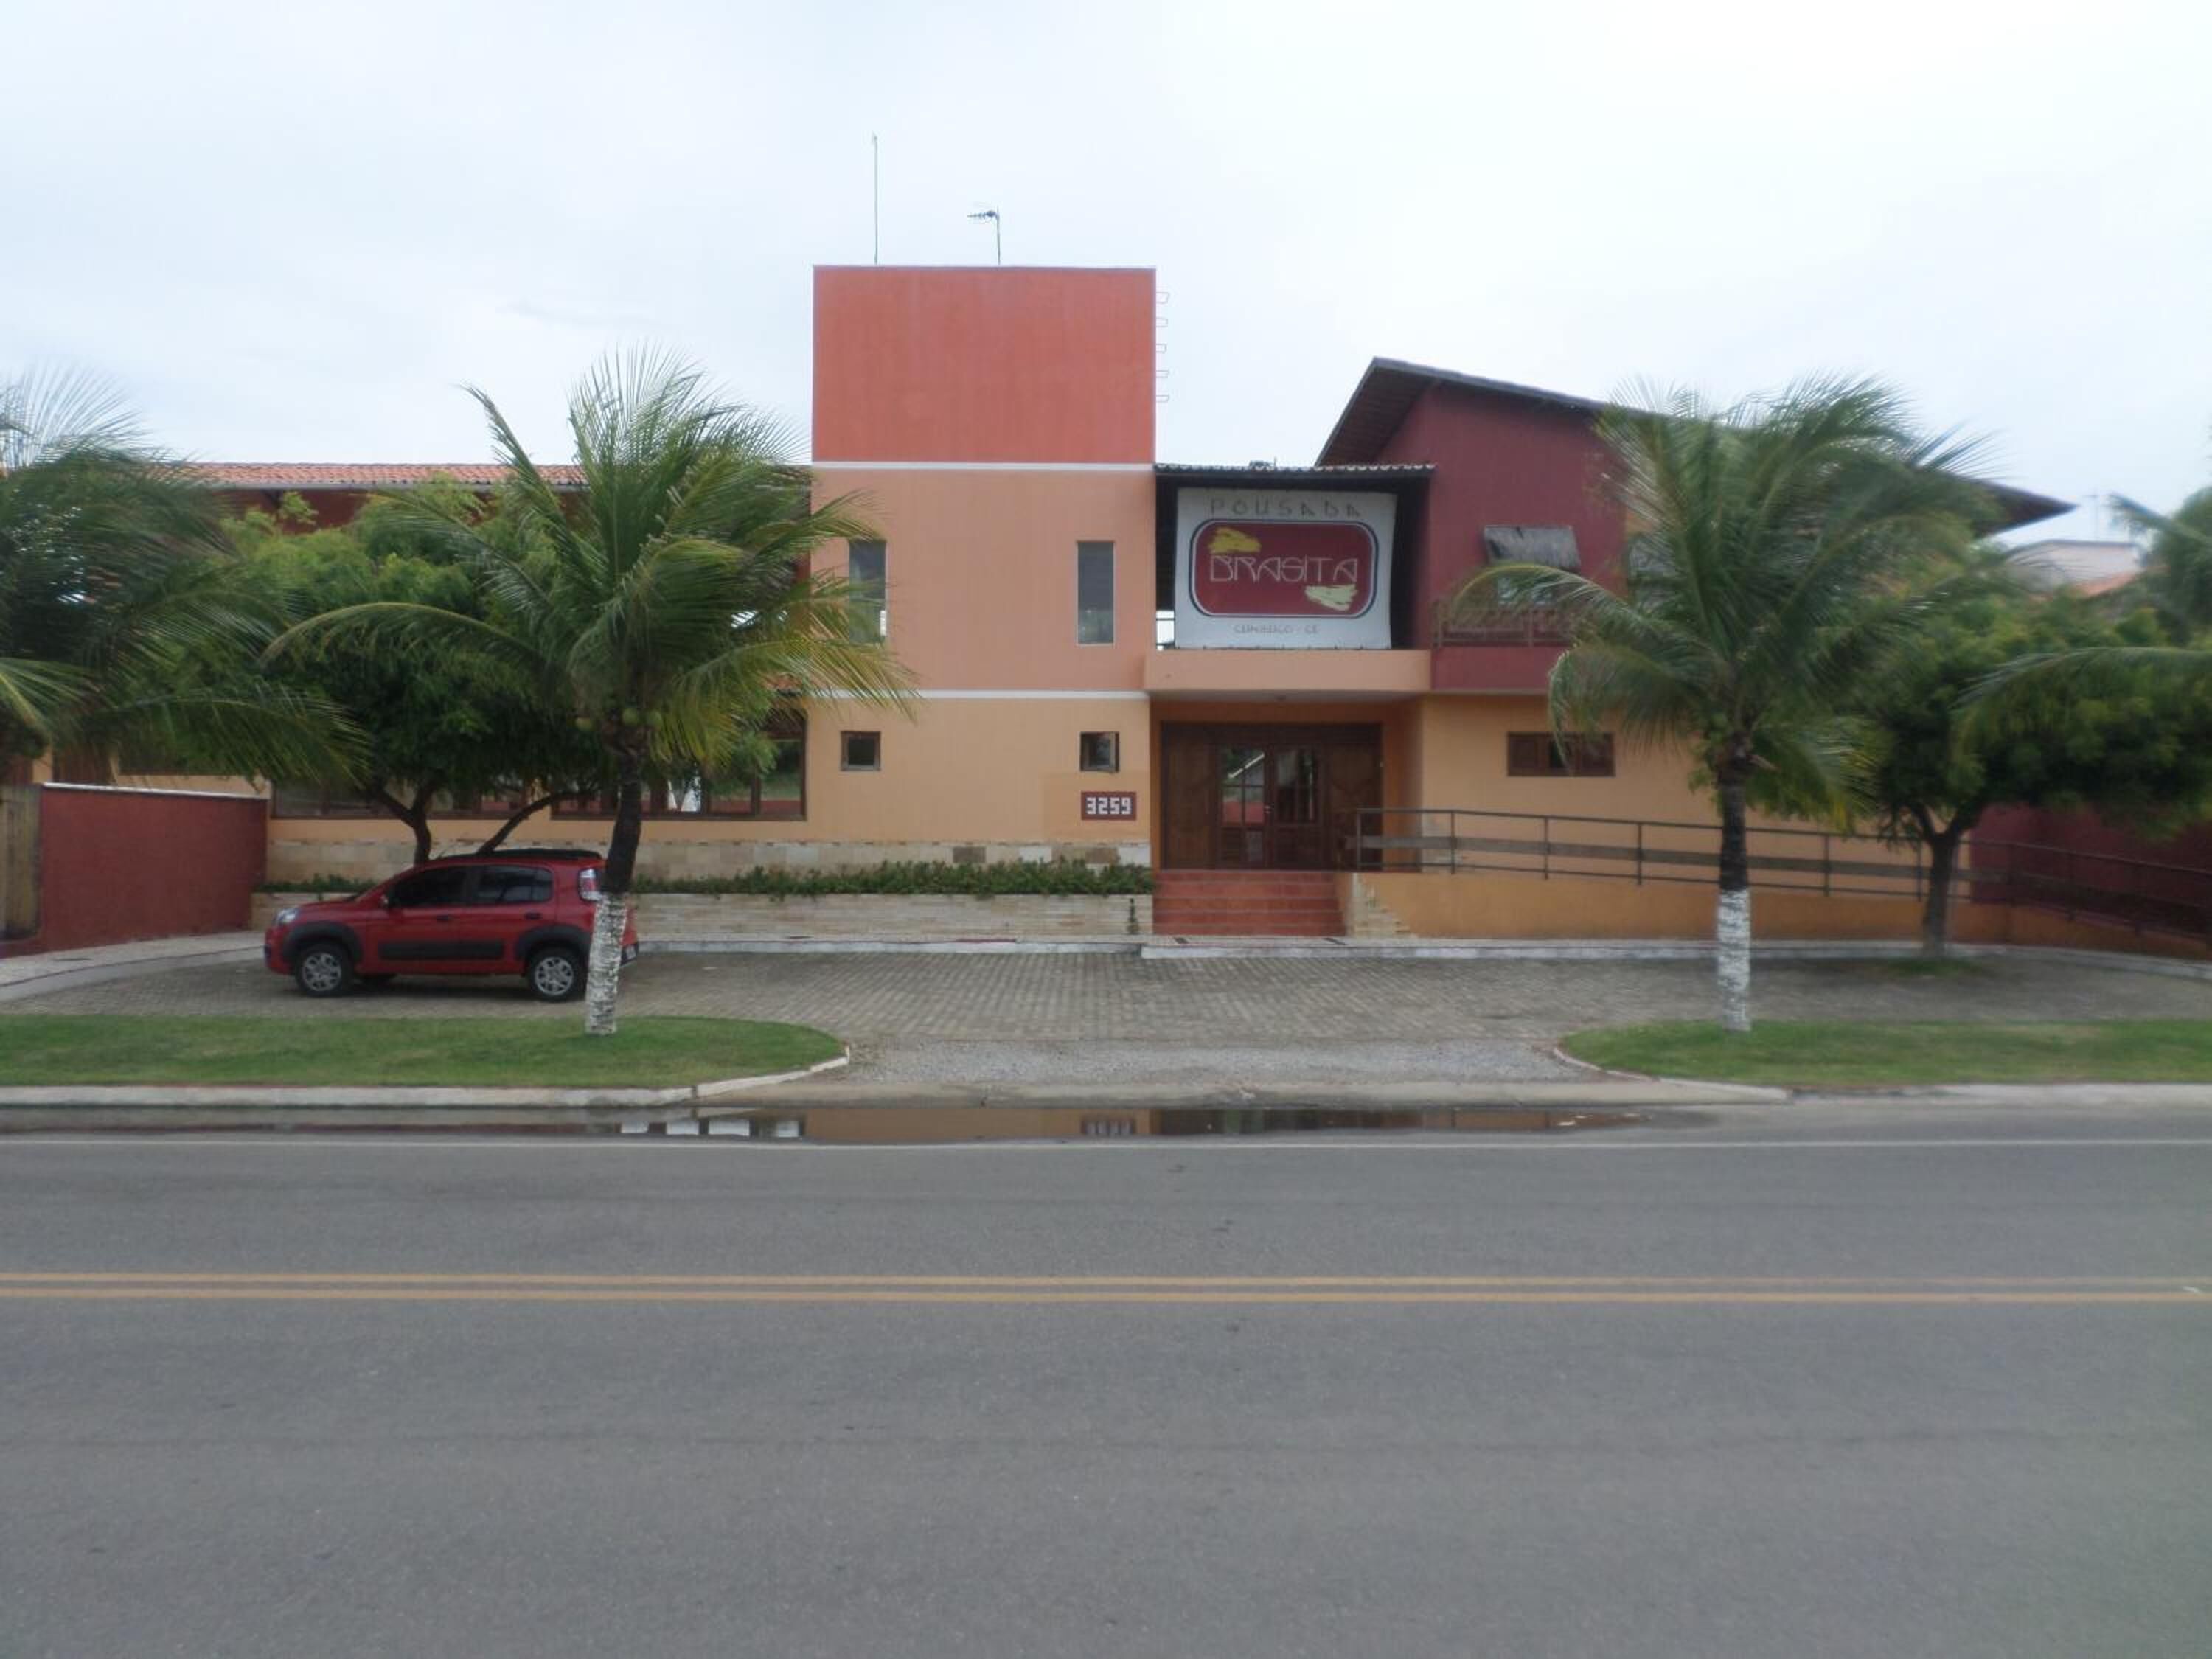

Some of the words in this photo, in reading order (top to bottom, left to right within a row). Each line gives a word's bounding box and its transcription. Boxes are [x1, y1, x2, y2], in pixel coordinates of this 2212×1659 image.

[1210, 498, 1361, 518] POUSADA
[1210, 554, 1358, 582] BRASITA
[1085, 797, 1131, 815] 3259
